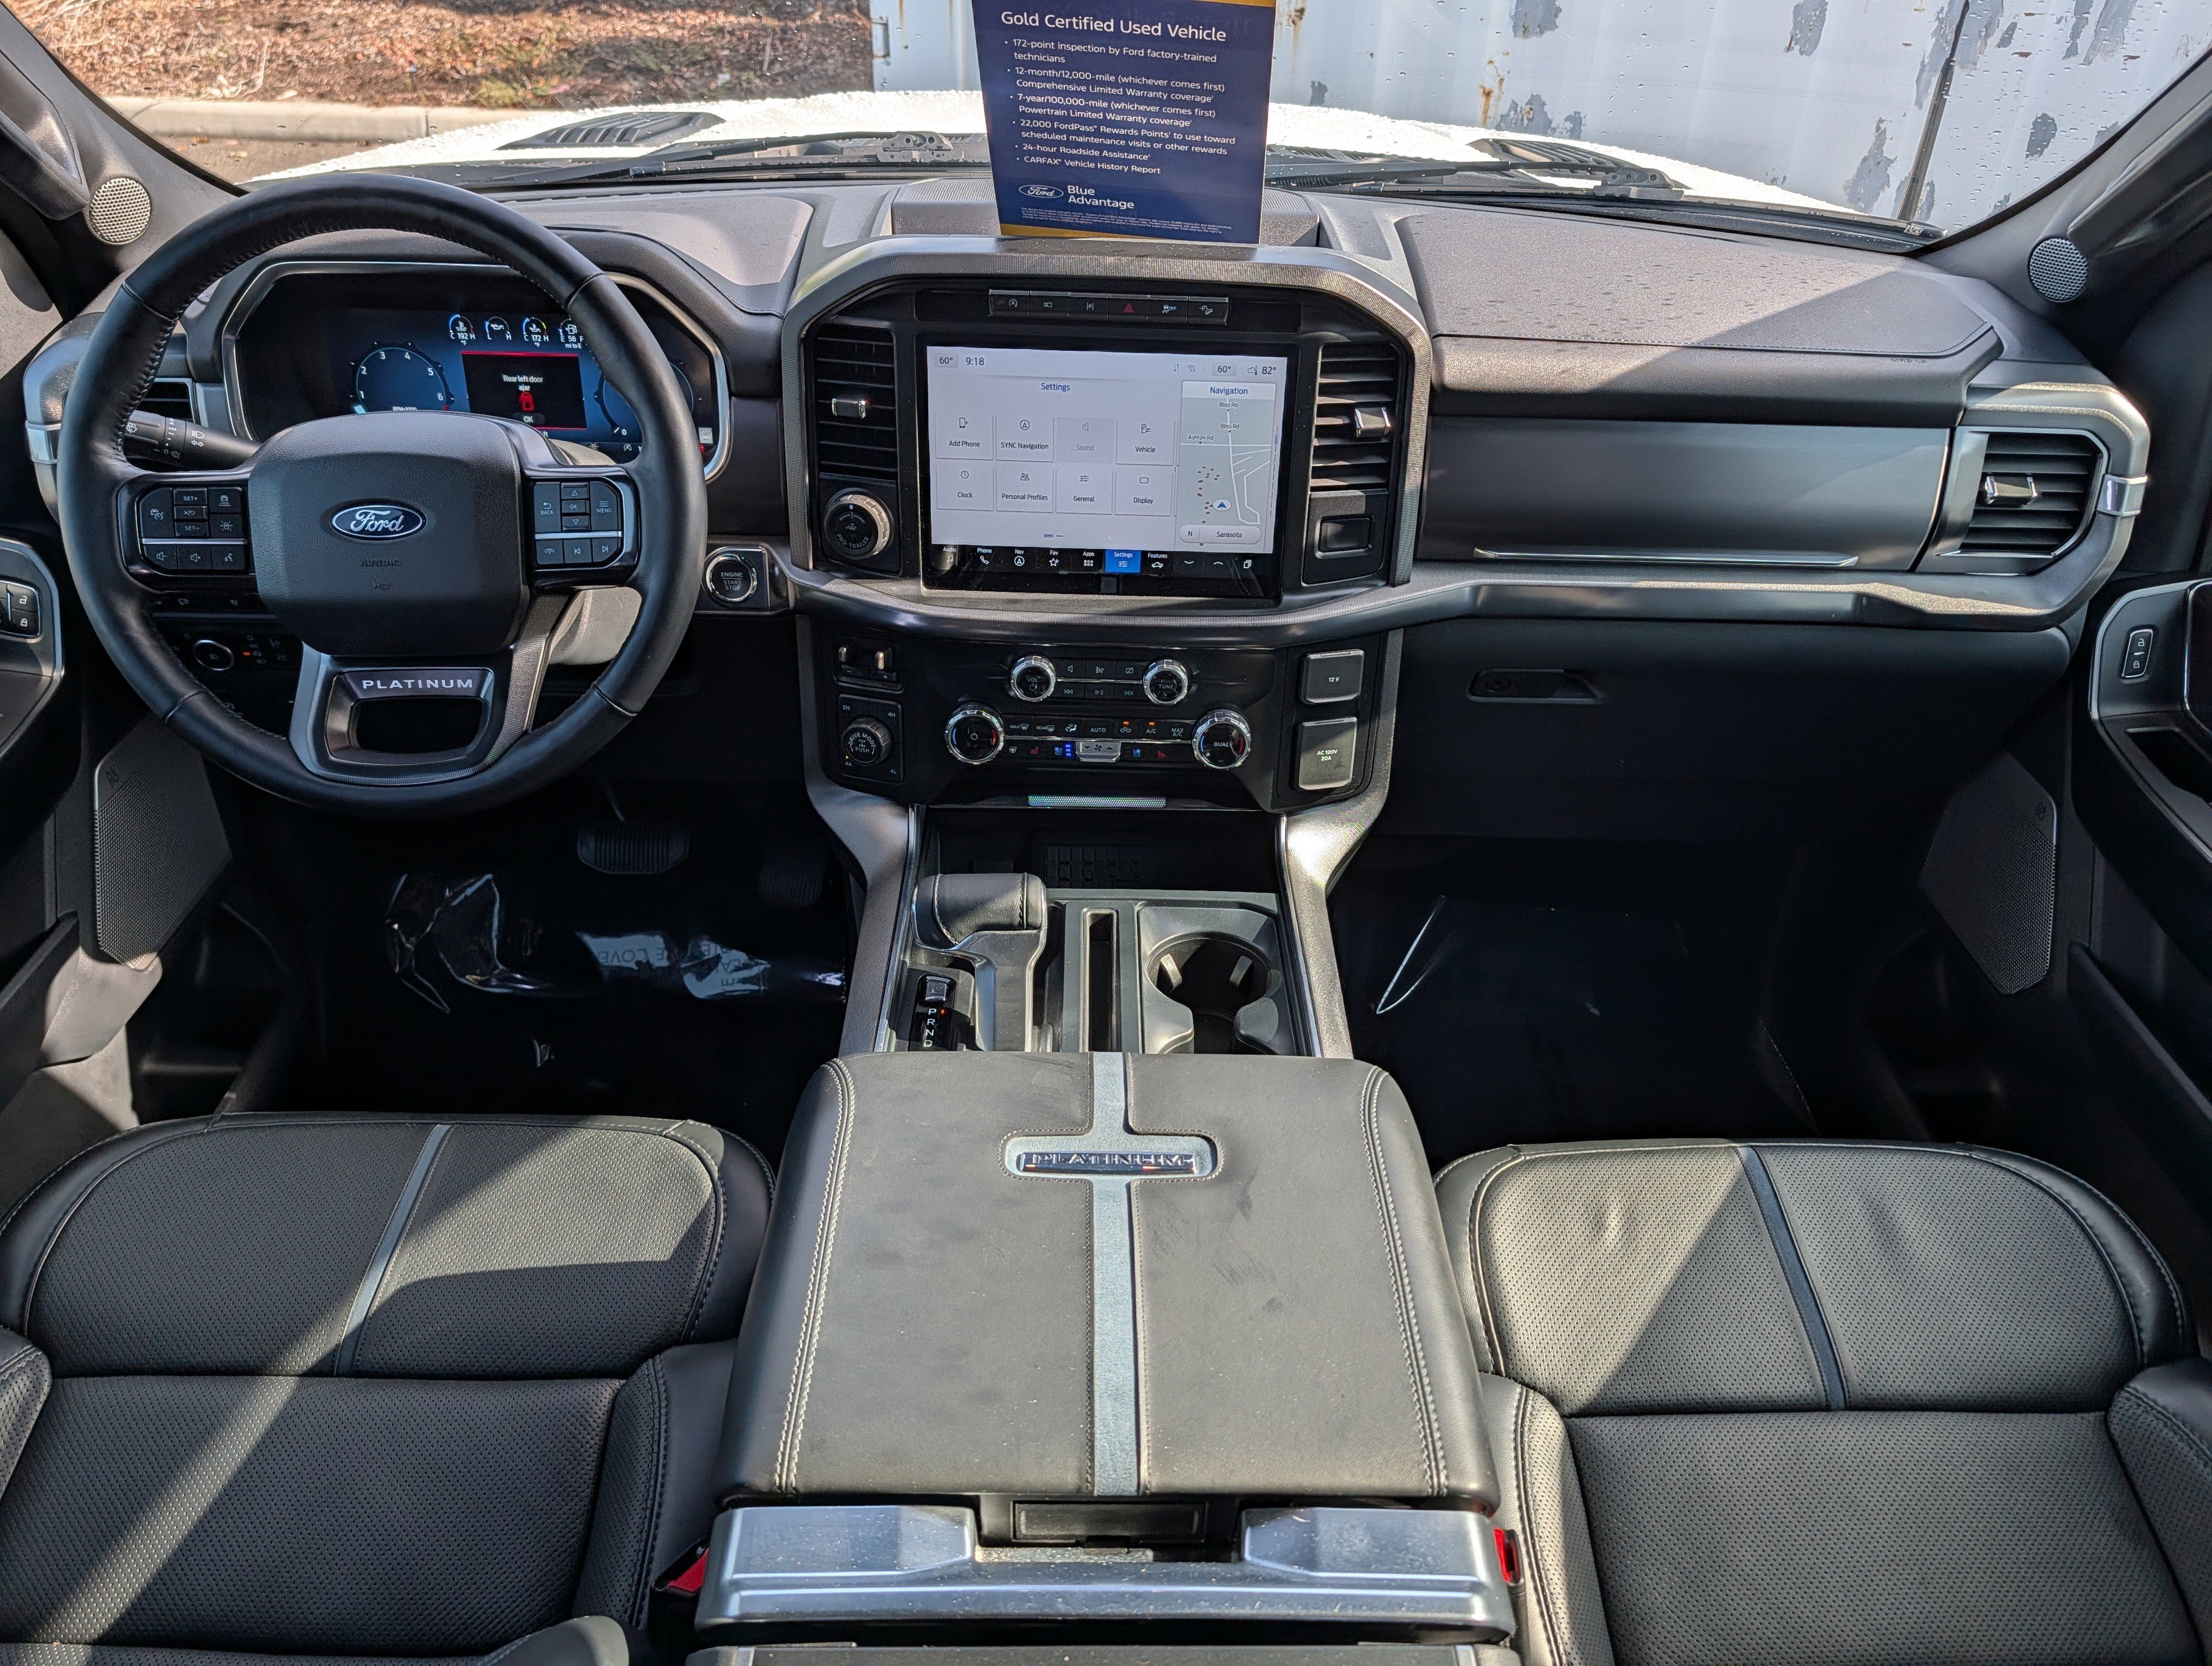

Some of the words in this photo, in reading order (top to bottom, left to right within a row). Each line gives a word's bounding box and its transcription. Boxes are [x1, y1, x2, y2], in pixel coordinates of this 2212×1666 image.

[1001, 11, 1039, 26] Gold
[1045, 15, 1114, 32] Certified
[1120, 20, 1161, 36] Used
[1167, 24, 1226, 41] Vehicle
[1013, 39, 1055, 49] 172-point
[1057, 42, 1105, 53] inspection
[1109, 46, 1120, 55] by
[1123, 47, 1144, 56] Ford
[1147, 49, 1217, 62] factory-trained
[1014, 52, 1065, 63] technicians
[1015, 67, 1115, 82] 12-month/12,000-mile
[1118, 75, 1168, 87] (whichever
[1204, 82, 1225, 92] first)
[1017, 79, 1086, 92] Comprehensive
[1089, 85, 1123, 95] Limited
[1126, 88, 1167, 100] Warranty
[1018, 94, 1108, 108] 7-year/100,000-mile
[1111, 101, 1160, 112] (whichever
[1162, 107, 1192, 115] comes
[1194, 108, 1216, 118] first)
[1019, 106, 1067, 116] Powertrain
[1070, 110, 1103, 119] Limited
[1106, 112, 1147, 124] Warranty
[1020, 119, 1051, 128] 22,000
[1101, 126, 1138, 136] Rewards
[1204, 135, 1235, 144] toward
[1021, 131, 1066, 140] scheduled
[1070, 136, 1126, 146] maintenance
[1128, 139, 1151, 148] visits
[1165, 143, 1189, 151] other
[1192, 145, 1227, 155] rewards
[1023, 143, 1057, 152] 24-hour
[1060, 146, 1099, 156] Roadside
[1064, 159, 1095, 168] Vehicle
[1098, 162, 1128, 172] History
[1131, 165, 1161, 174] Report
[1068, 185, 1095, 195] Blue
[1068, 195, 1134, 209] Advantage
[380, 351, 386, 360] 3
[404, 352, 410, 360] 4
[966, 357, 985, 366] 9:18
[361, 366, 367, 375] 2
[427, 367, 434, 376] 5
[1217, 365, 1231, 373] 60°
[1262, 366, 1277, 375] 82°
[1041, 383, 1070, 392] Settings
[1210, 387, 1248, 395] Navigation
[359, 390, 364, 399] 1
[437, 393, 443, 401] 6
[1018, 442, 1049, 451] Navigation
[351, 509, 404, 531] Ford
[837, 534, 847, 545] PRO
[849, 537, 869, 548] TRAILER
[362, 679, 473, 689] PLATINUM
[848, 732, 861, 746] DRIVE
[861, 733, 876, 748] MODE
[1033, 1153, 1185, 1165] PLATINUM
